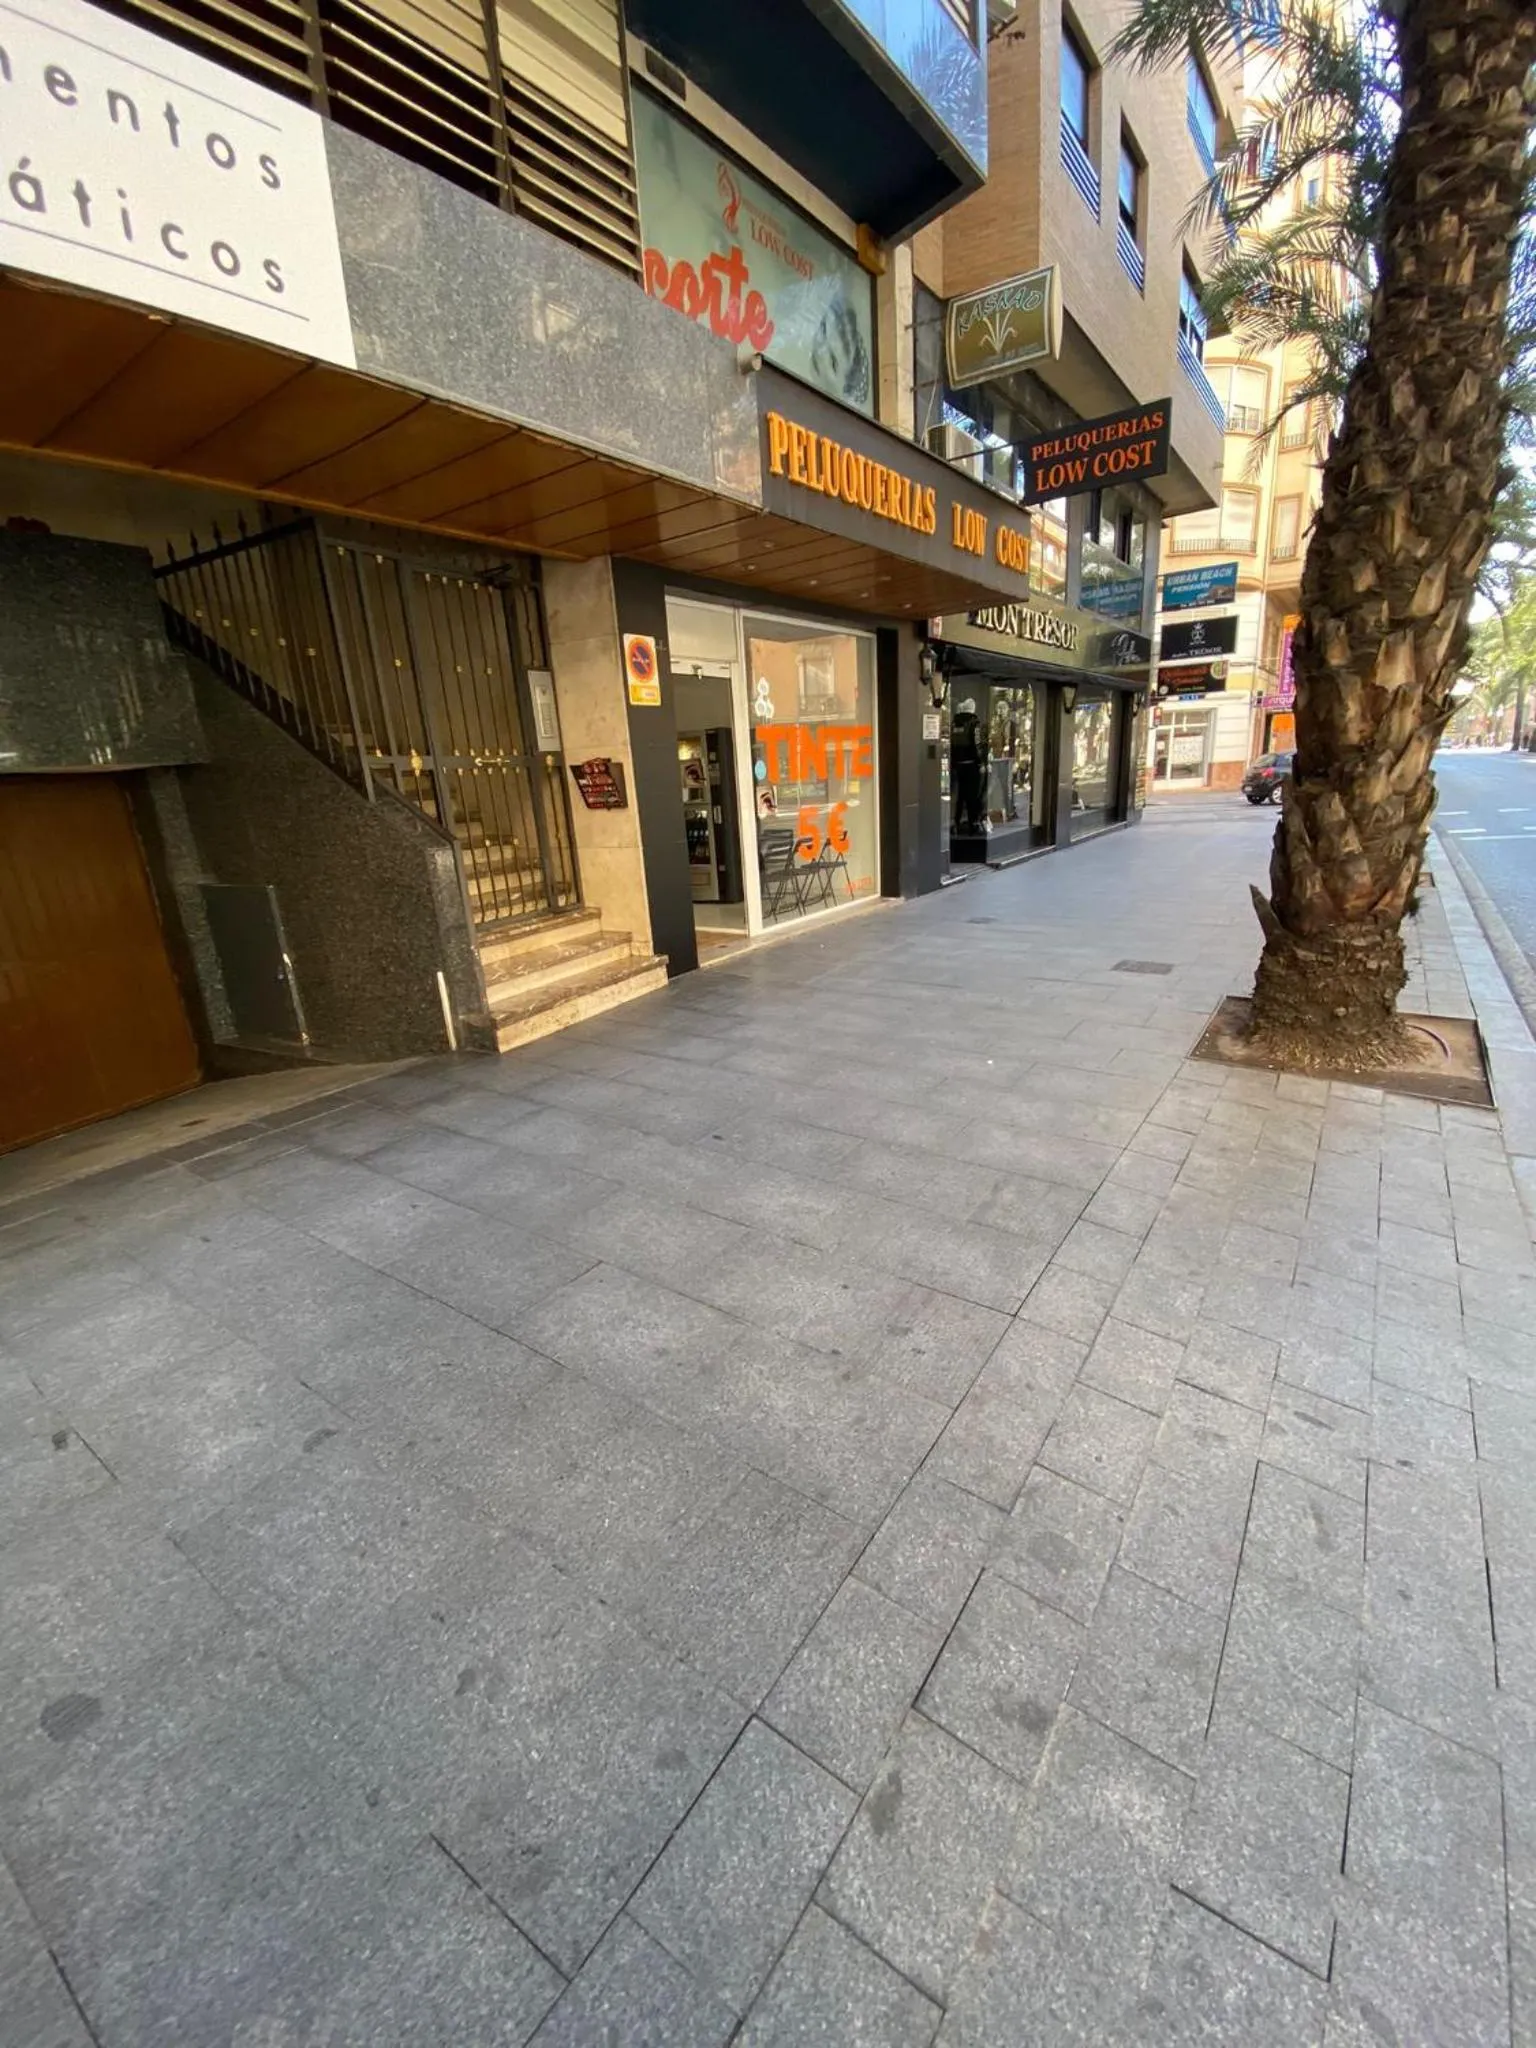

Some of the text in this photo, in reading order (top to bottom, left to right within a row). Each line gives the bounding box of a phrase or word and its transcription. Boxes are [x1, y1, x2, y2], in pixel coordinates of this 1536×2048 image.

[0, 46, 281, 190] entos
[1031, 411, 1164, 462] PELUQUERIAS
[1036, 440, 1157, 492] LOW COST
[767, 411, 1032, 574] PELUQUERIAS LOW COST
[1166, 567, 1233, 586] URBAN BEACH
[975, 604, 1018, 635] MON
[1021, 608, 1080, 650] TRÉSOR
[755, 724, 873, 785] TINTE
